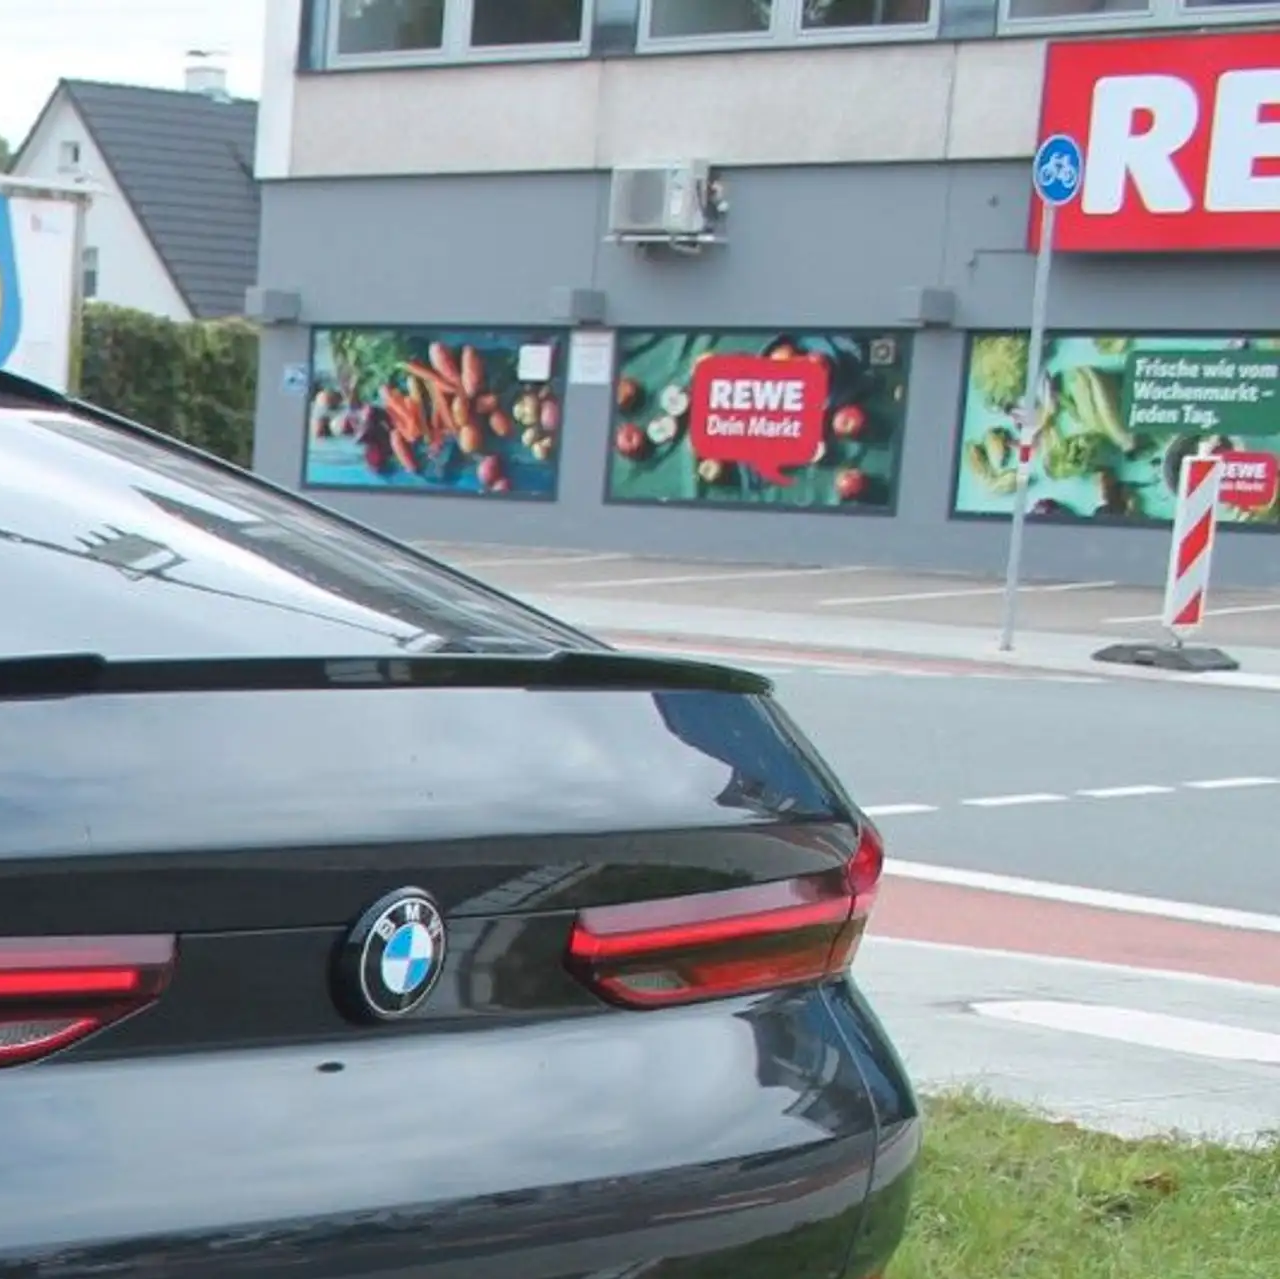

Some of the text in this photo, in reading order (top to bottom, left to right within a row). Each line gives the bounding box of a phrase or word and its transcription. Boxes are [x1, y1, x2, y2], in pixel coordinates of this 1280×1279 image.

[1081, 67, 1280, 214] RE
[1135, 358, 1279, 378] Frische wie vom
[709, 379, 805, 411] REWE
[1133, 381, 1259, 402] Wochenmarkt
[706, 414, 802, 438] Dein Markt
[1129, 404, 1220, 429] jeden Tag.
[376, 903, 442, 941] BMW
